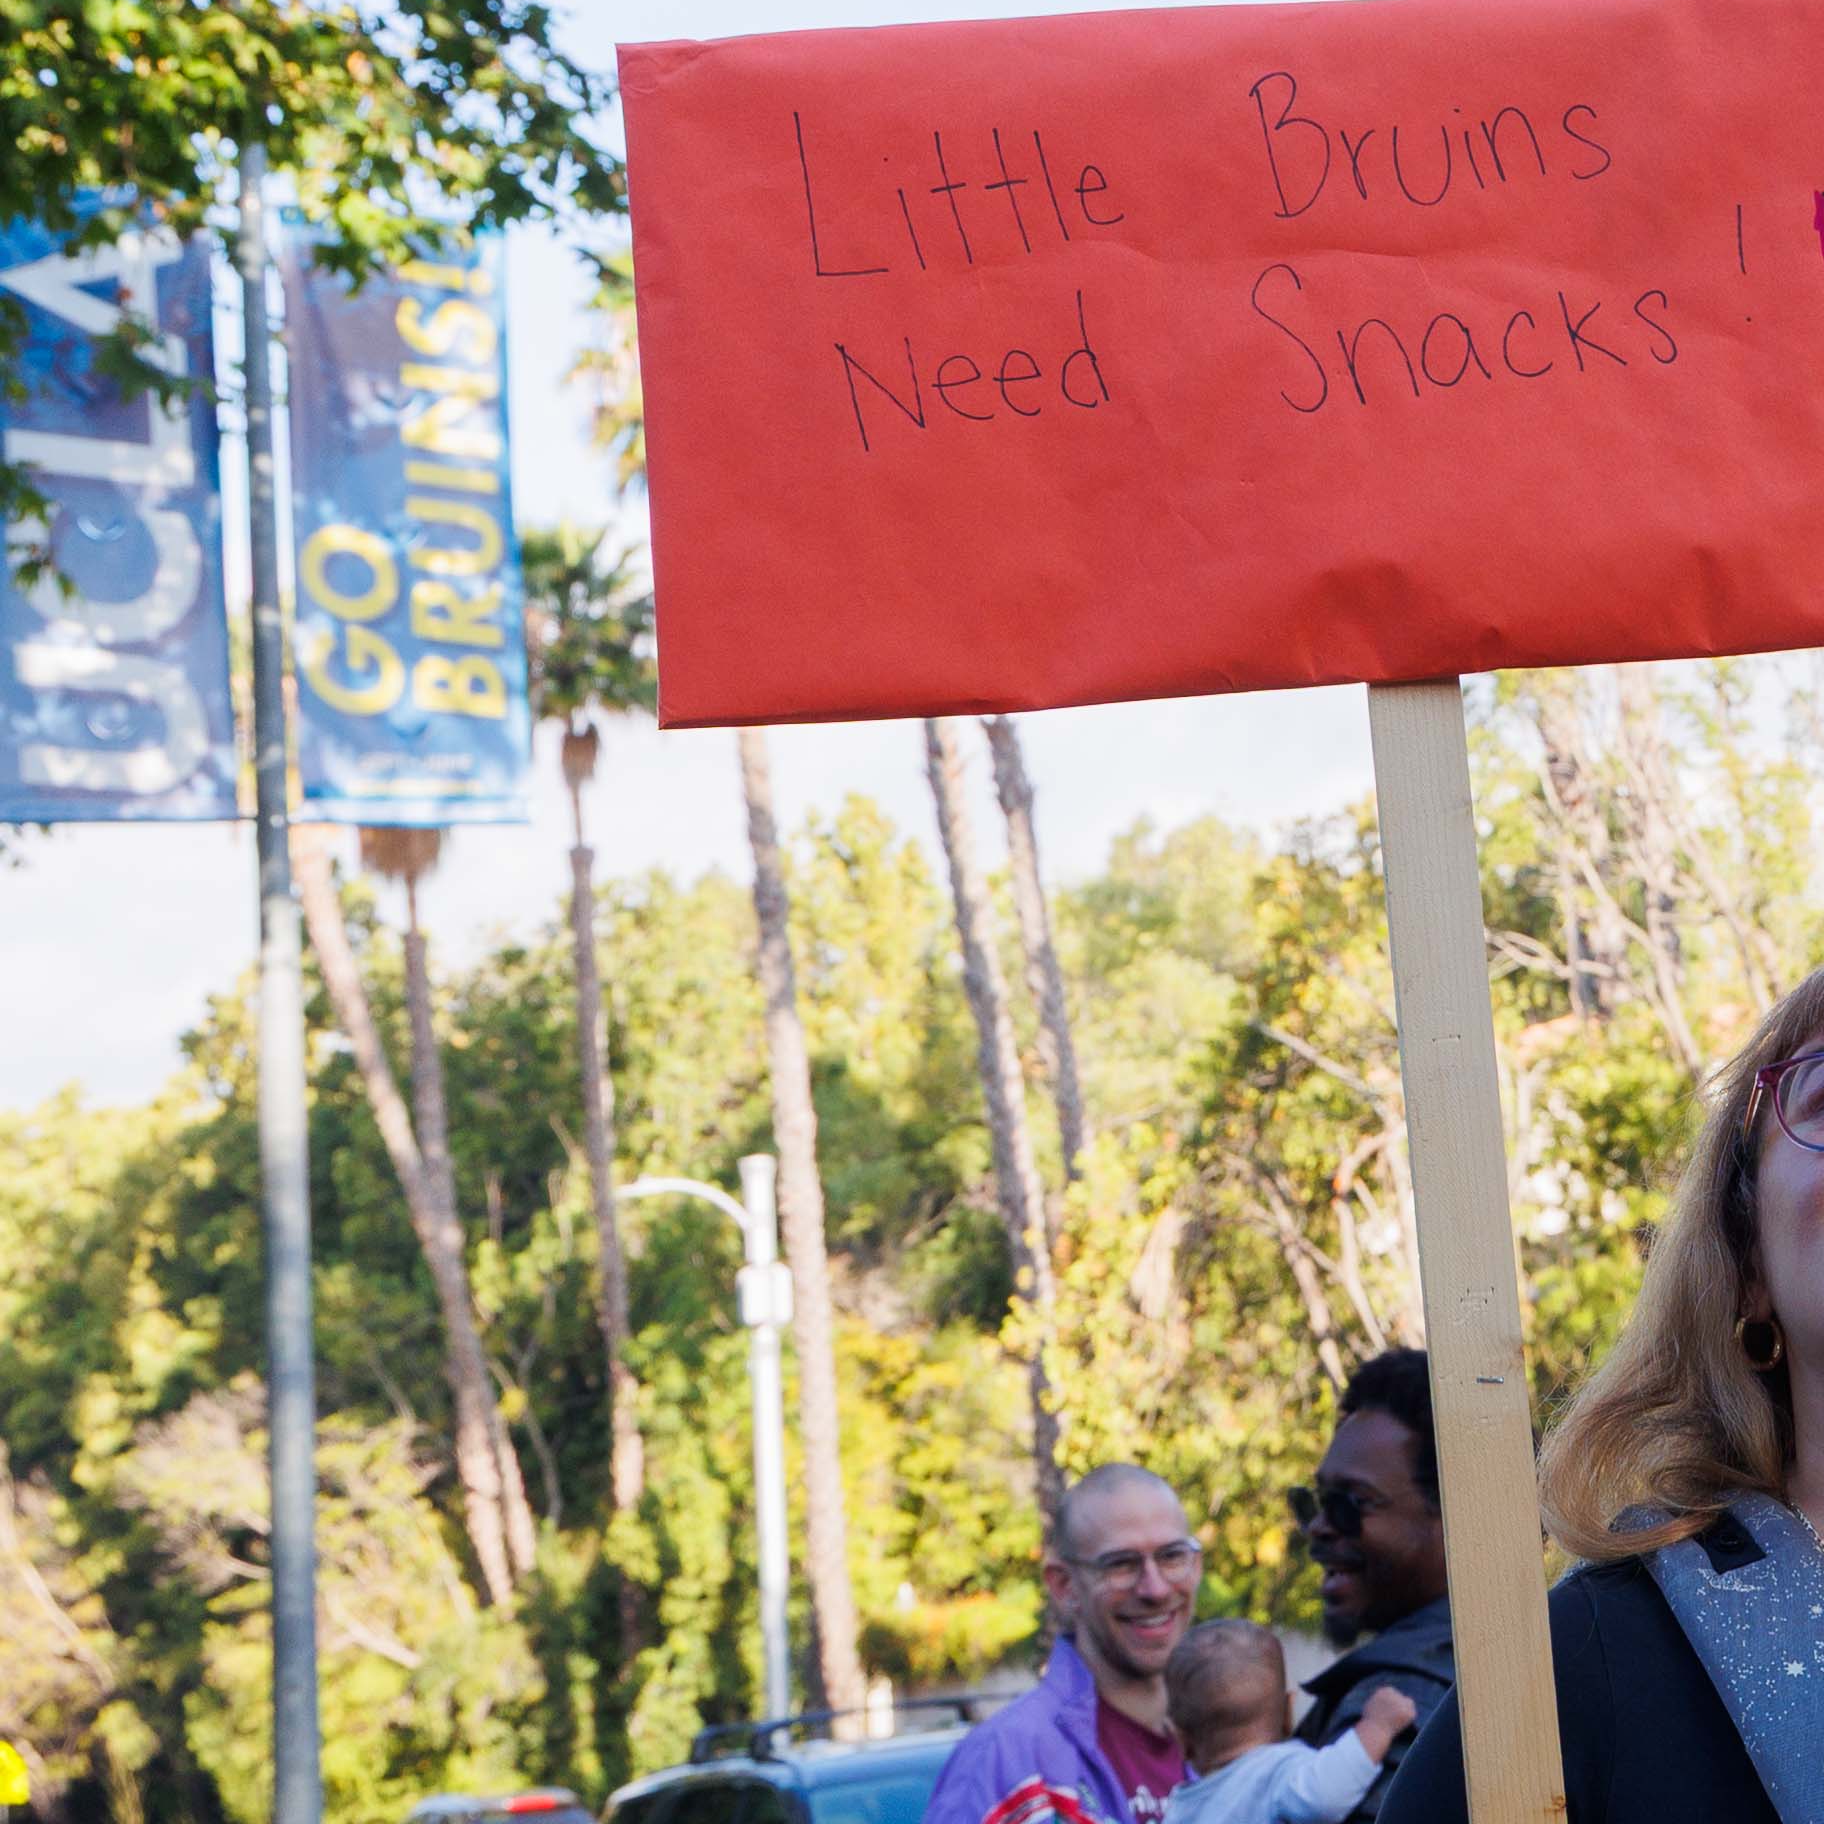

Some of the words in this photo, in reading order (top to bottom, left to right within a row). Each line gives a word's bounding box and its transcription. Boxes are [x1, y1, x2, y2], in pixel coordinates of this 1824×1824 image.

[793, 111, 1125, 277] Little
[1250, 72, 1611, 219] Bruins
[834, 290, 1112, 453] Need
[0, 224, 210, 792] UCLA
[395, 258, 508, 717] BRUINS!
[303, 524, 403, 716] GO
